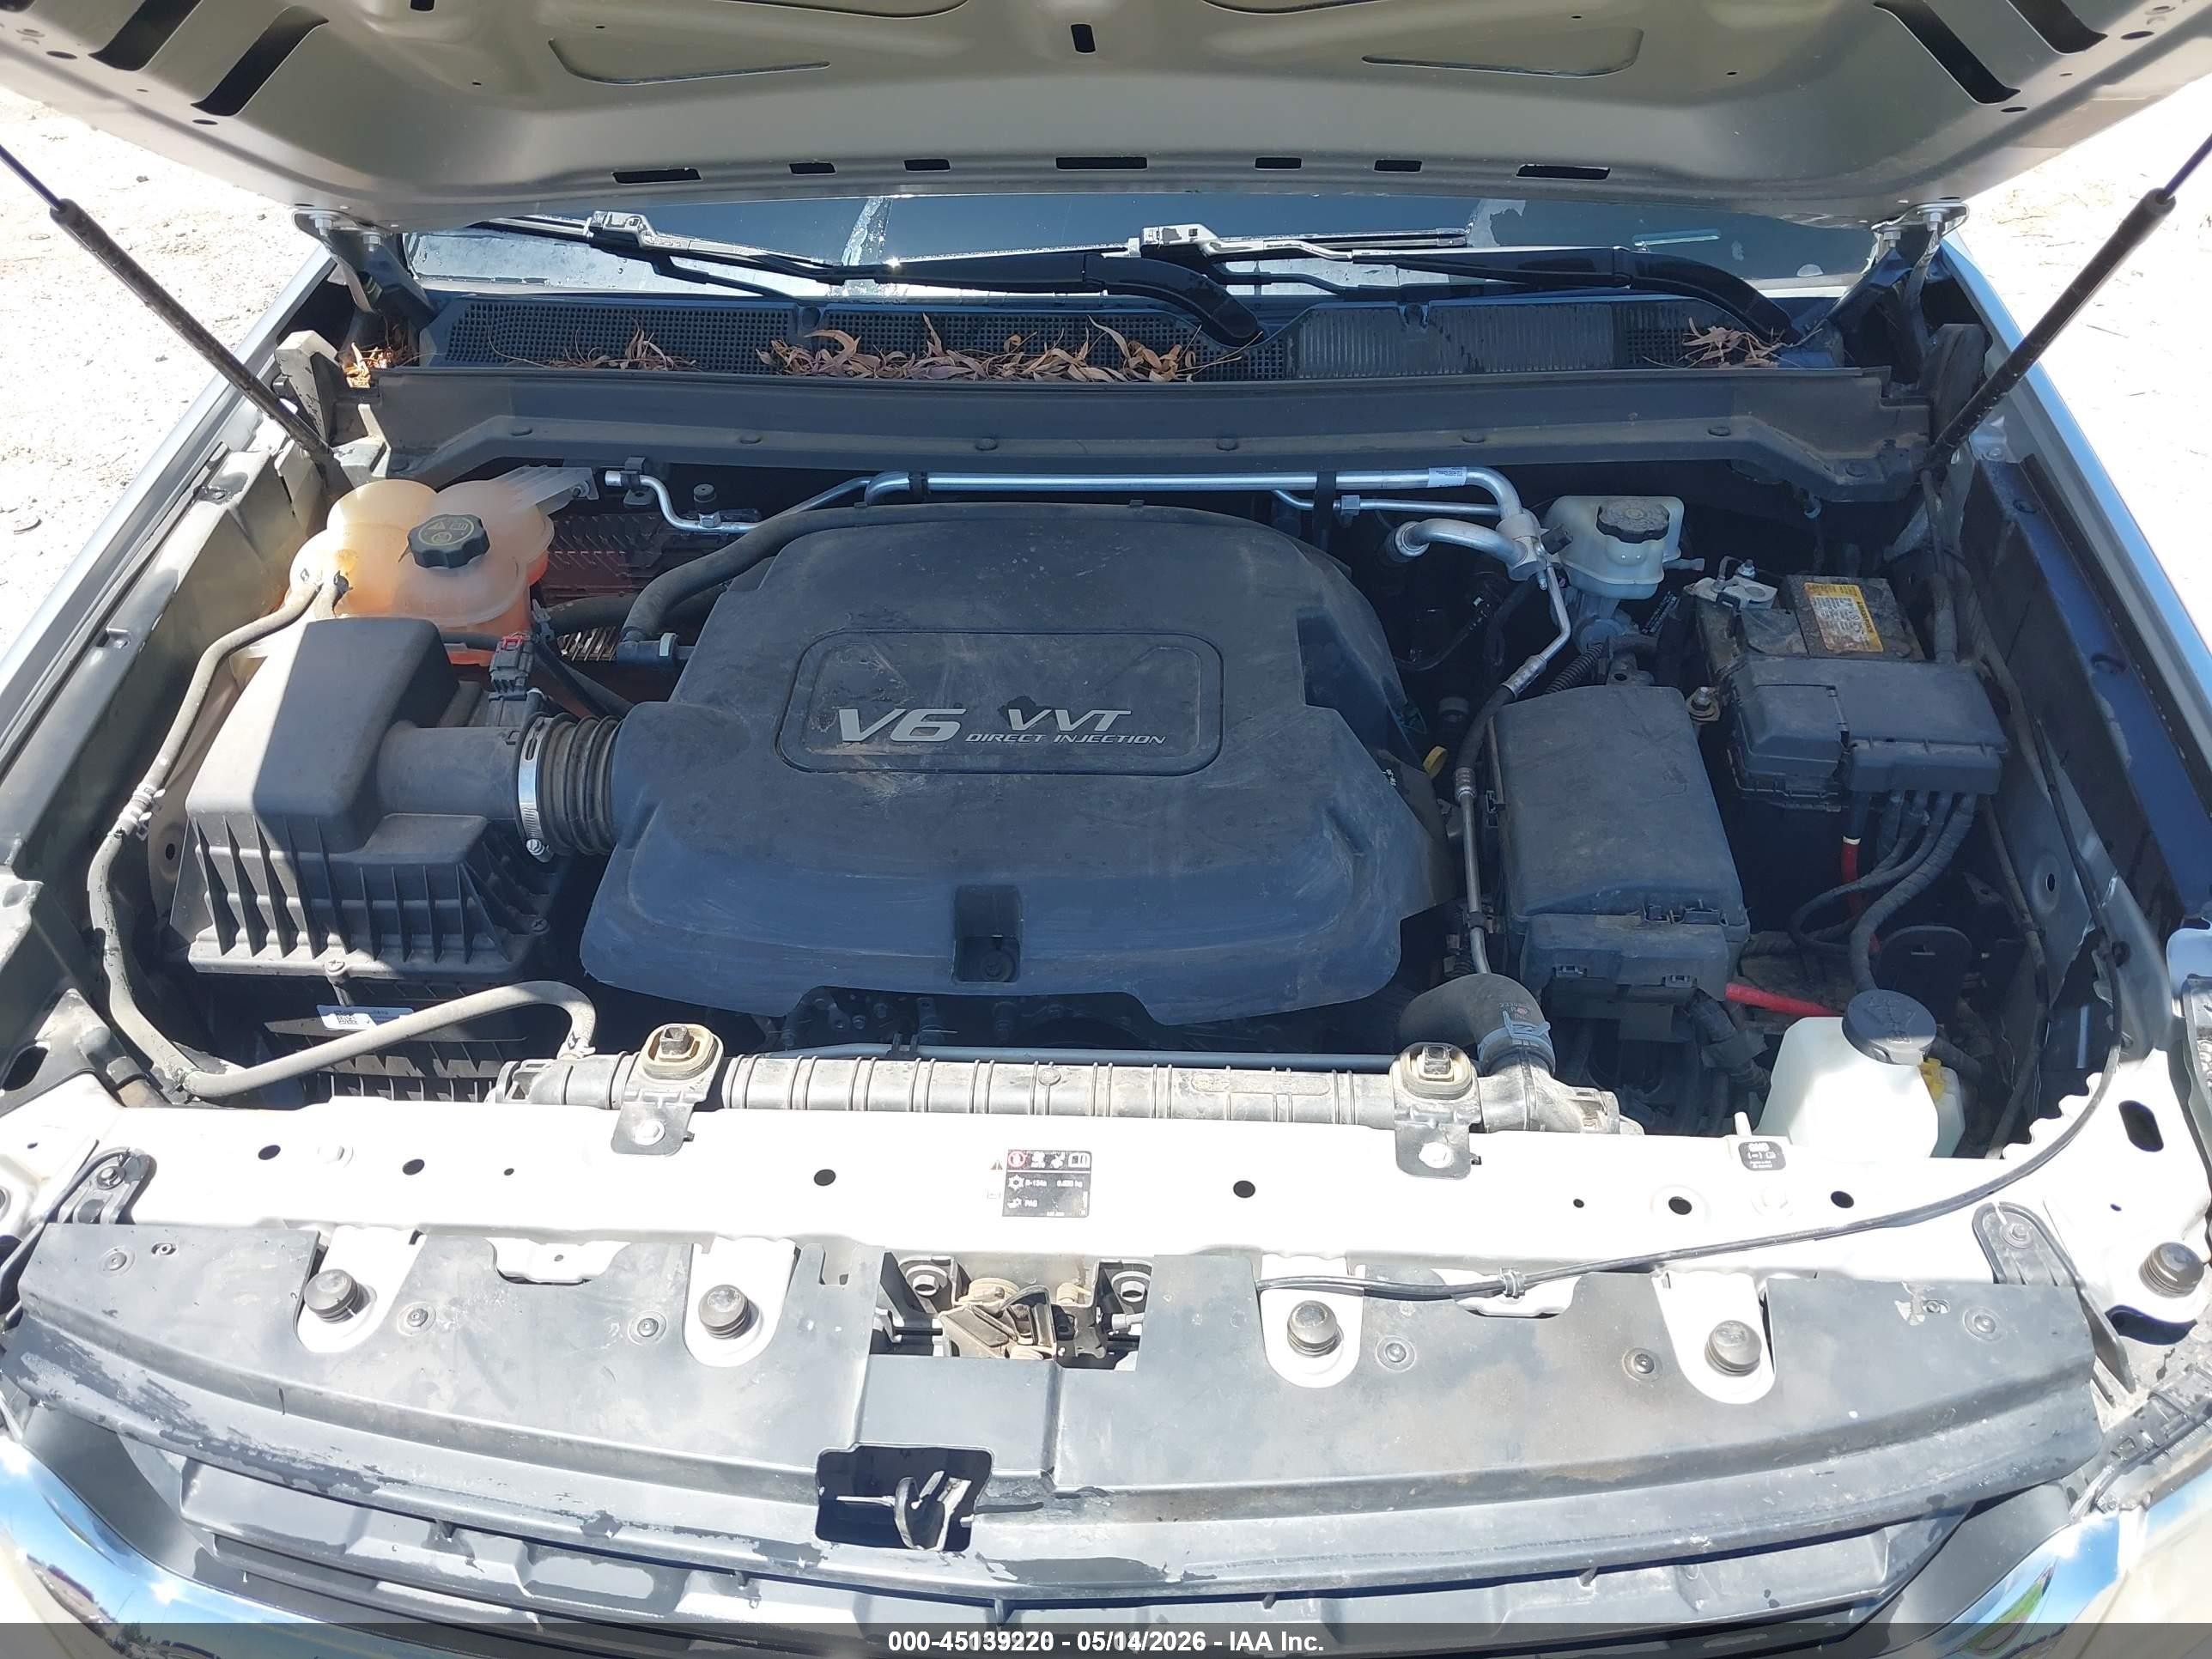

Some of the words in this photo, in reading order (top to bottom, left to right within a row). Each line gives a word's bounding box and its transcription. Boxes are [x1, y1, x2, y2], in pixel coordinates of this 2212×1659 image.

[837, 708, 967, 743] V6
[1008, 708, 1132, 732] VVT
[965, 733, 1048, 744] DIRECT
[1053, 733, 1167, 744] INJECTION
